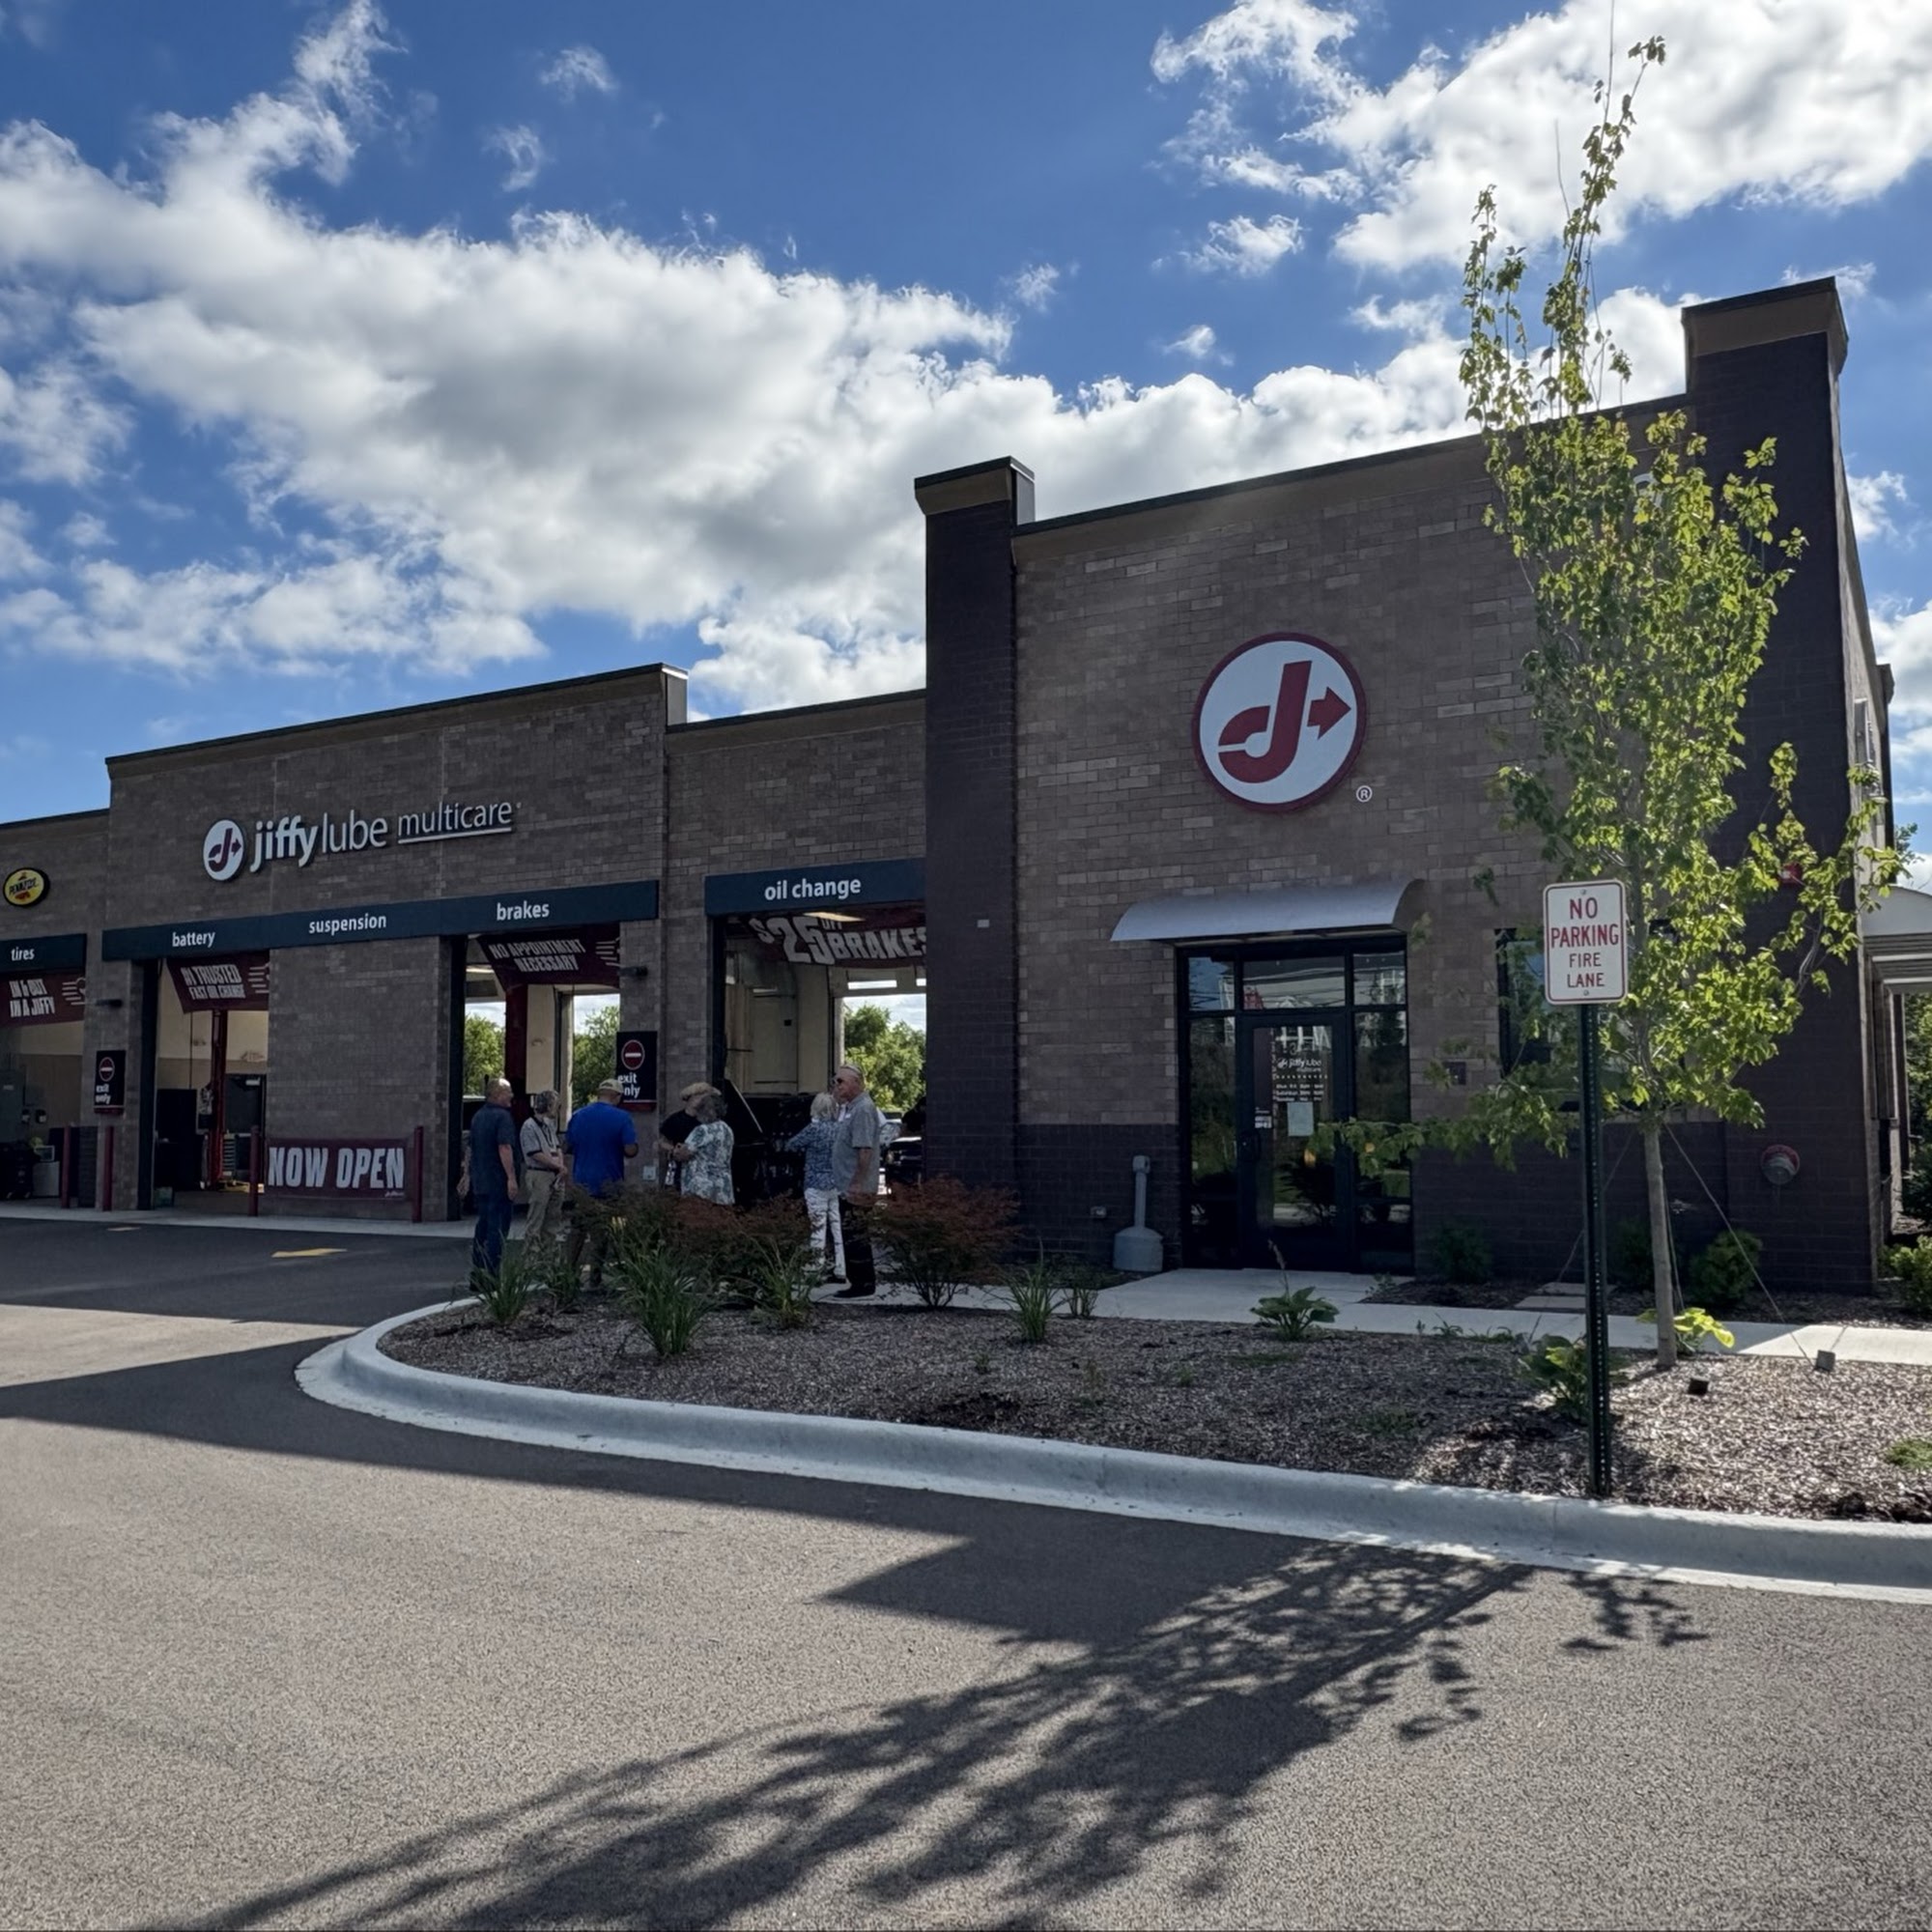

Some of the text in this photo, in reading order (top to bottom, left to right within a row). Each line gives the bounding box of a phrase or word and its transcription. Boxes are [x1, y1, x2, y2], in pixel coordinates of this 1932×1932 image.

[250, 802, 512, 872] jiffy lube multicare
[764, 878, 862, 900] oil change
[497, 899, 550, 921] brakes
[1570, 897, 1598, 920] NO
[308, 913, 386, 936] suspension
[172, 931, 215, 948] battery
[1551, 923, 1619, 948] PARKING
[11, 947, 35, 962] tires
[488, 939, 586, 959] NO APPOINTMENT
[514, 954, 580, 973] NECESSARY
[1570, 952, 1602, 968] FIRE
[191, 964, 242, 984] TRUSTED
[1567, 973, 1605, 988] LANE
[617, 1071, 638, 1084] exit
[624, 1084, 641, 1099] nly
[268, 1147, 405, 1188] NOW OPEN
